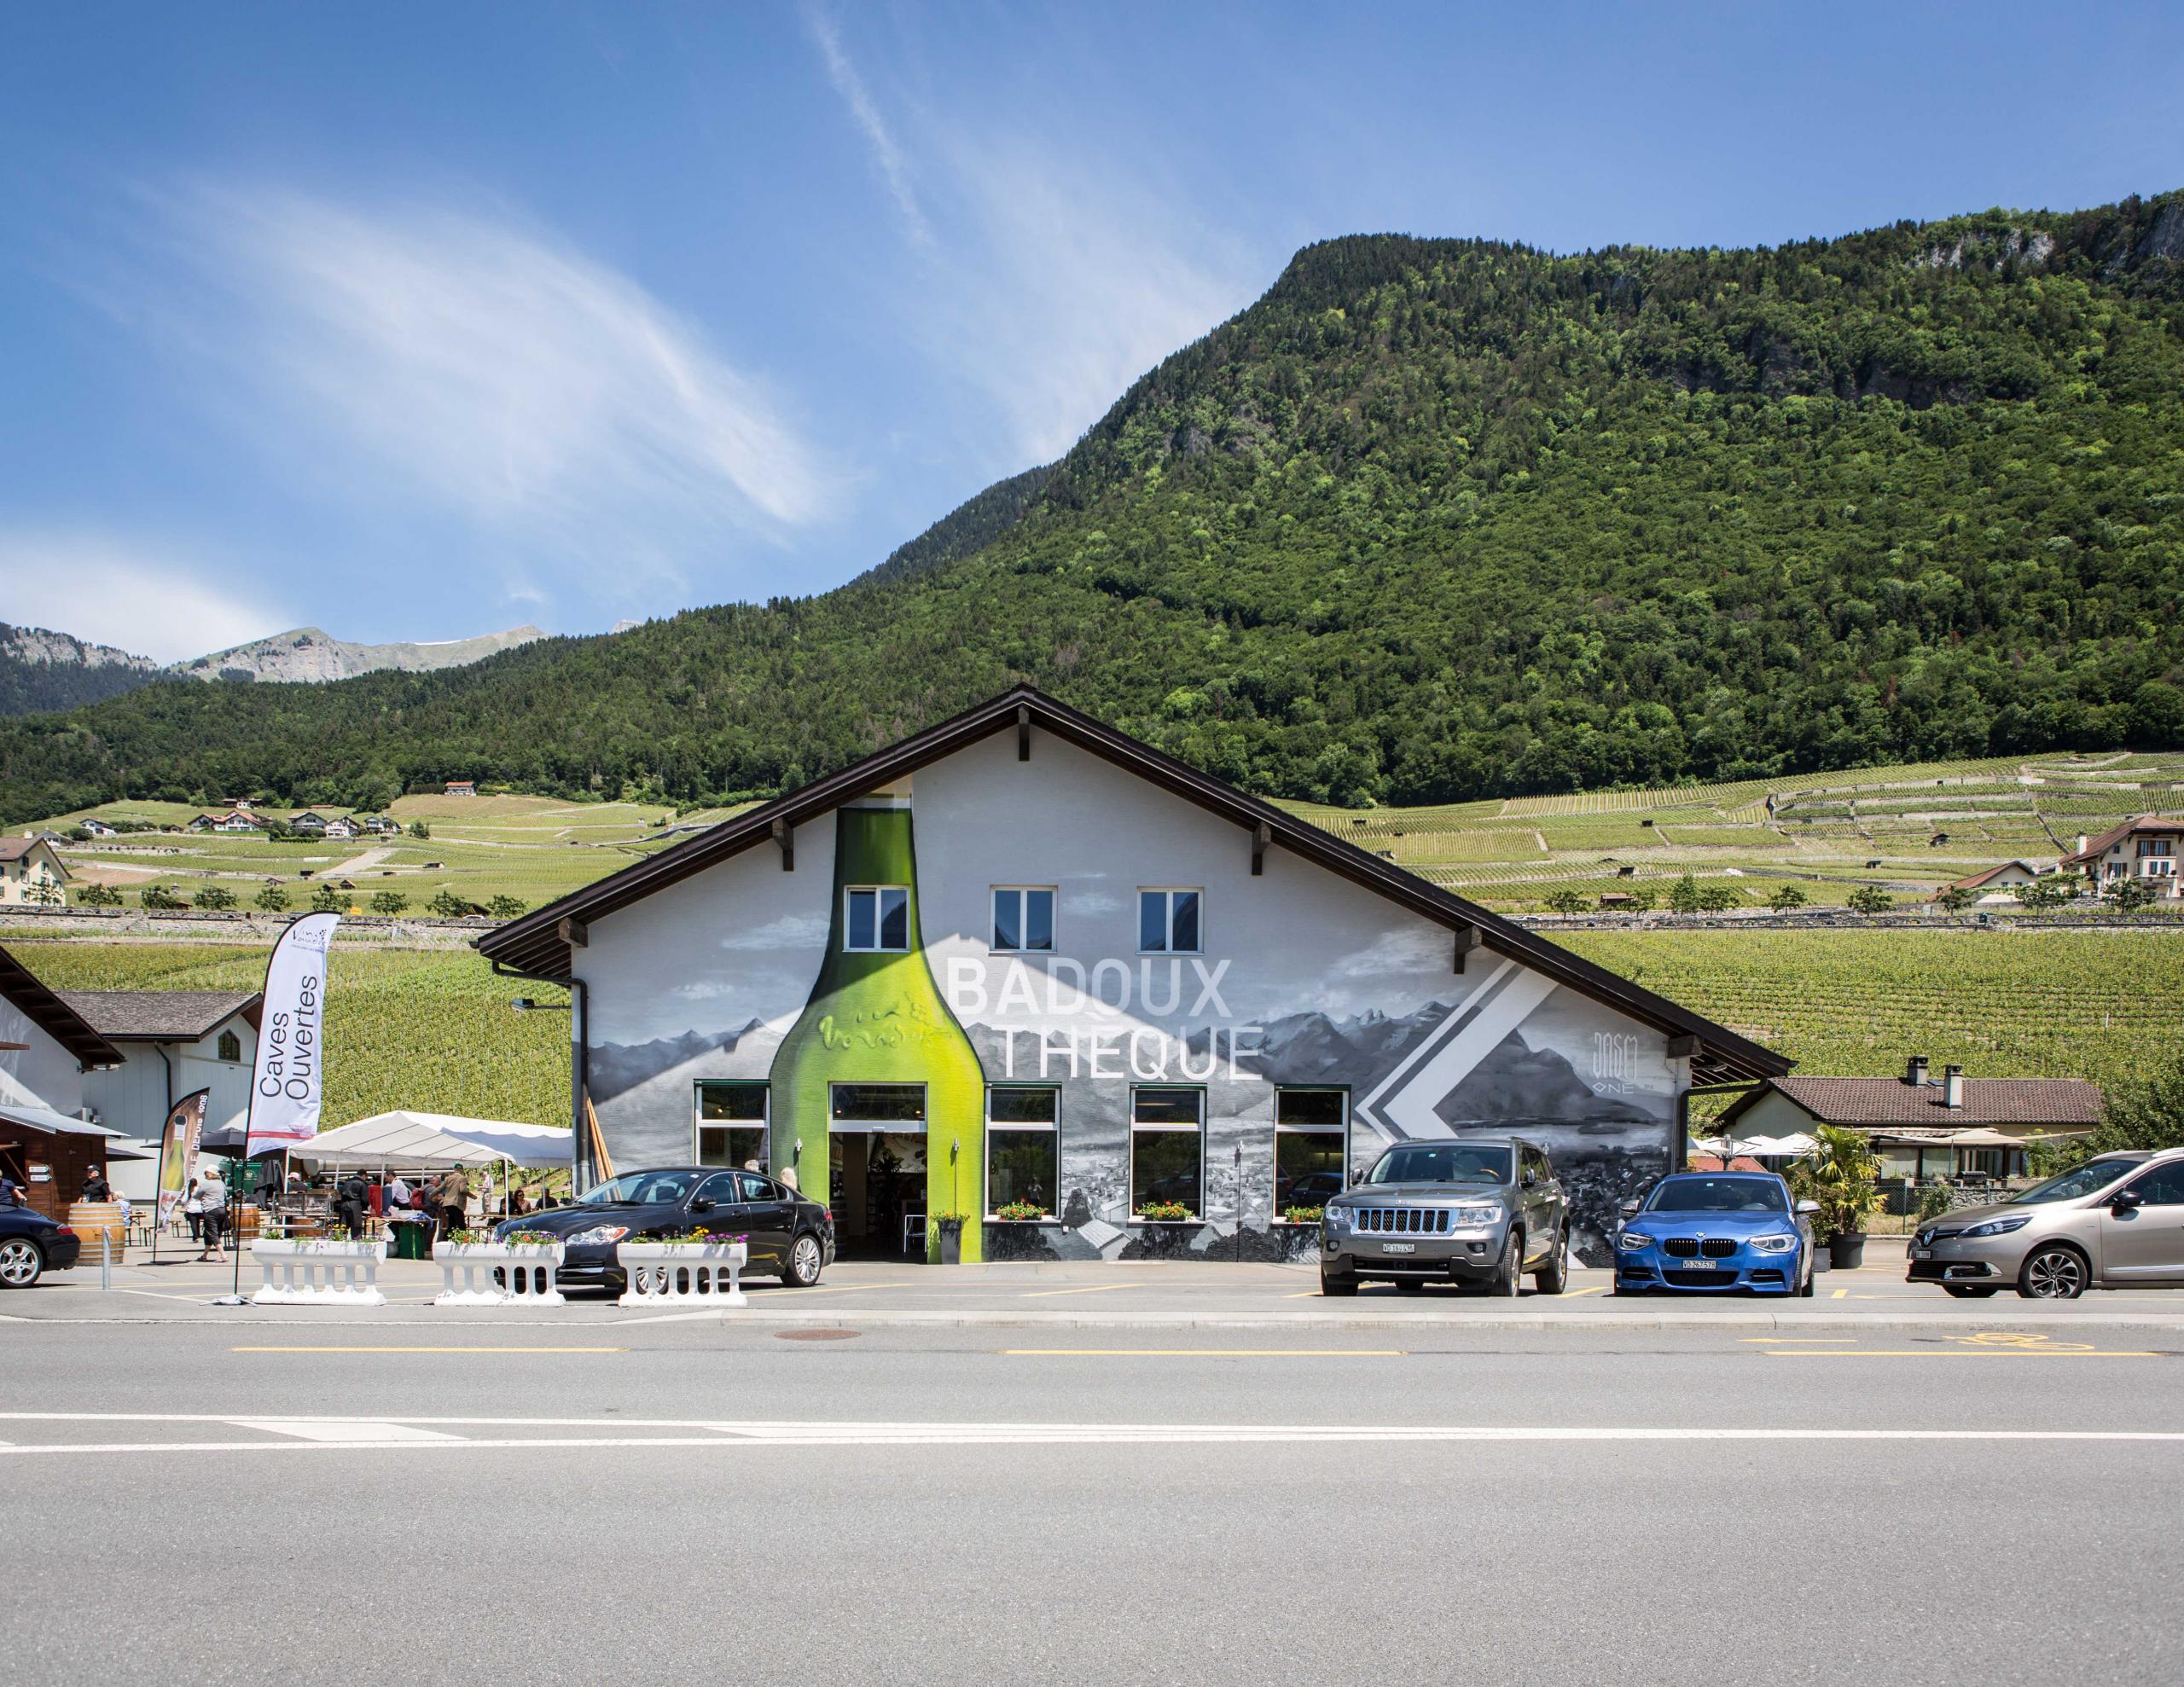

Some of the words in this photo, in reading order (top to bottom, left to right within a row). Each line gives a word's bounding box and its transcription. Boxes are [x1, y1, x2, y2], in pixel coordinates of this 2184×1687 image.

[946, 956, 1233, 1018] BADOUX
[259, 1012, 289, 1098] Caves
[284, 975, 317, 1100] Ouvertes
[990, 1024, 1263, 1081] THEQUE
[1592, 1081, 1635, 1094] ONE
